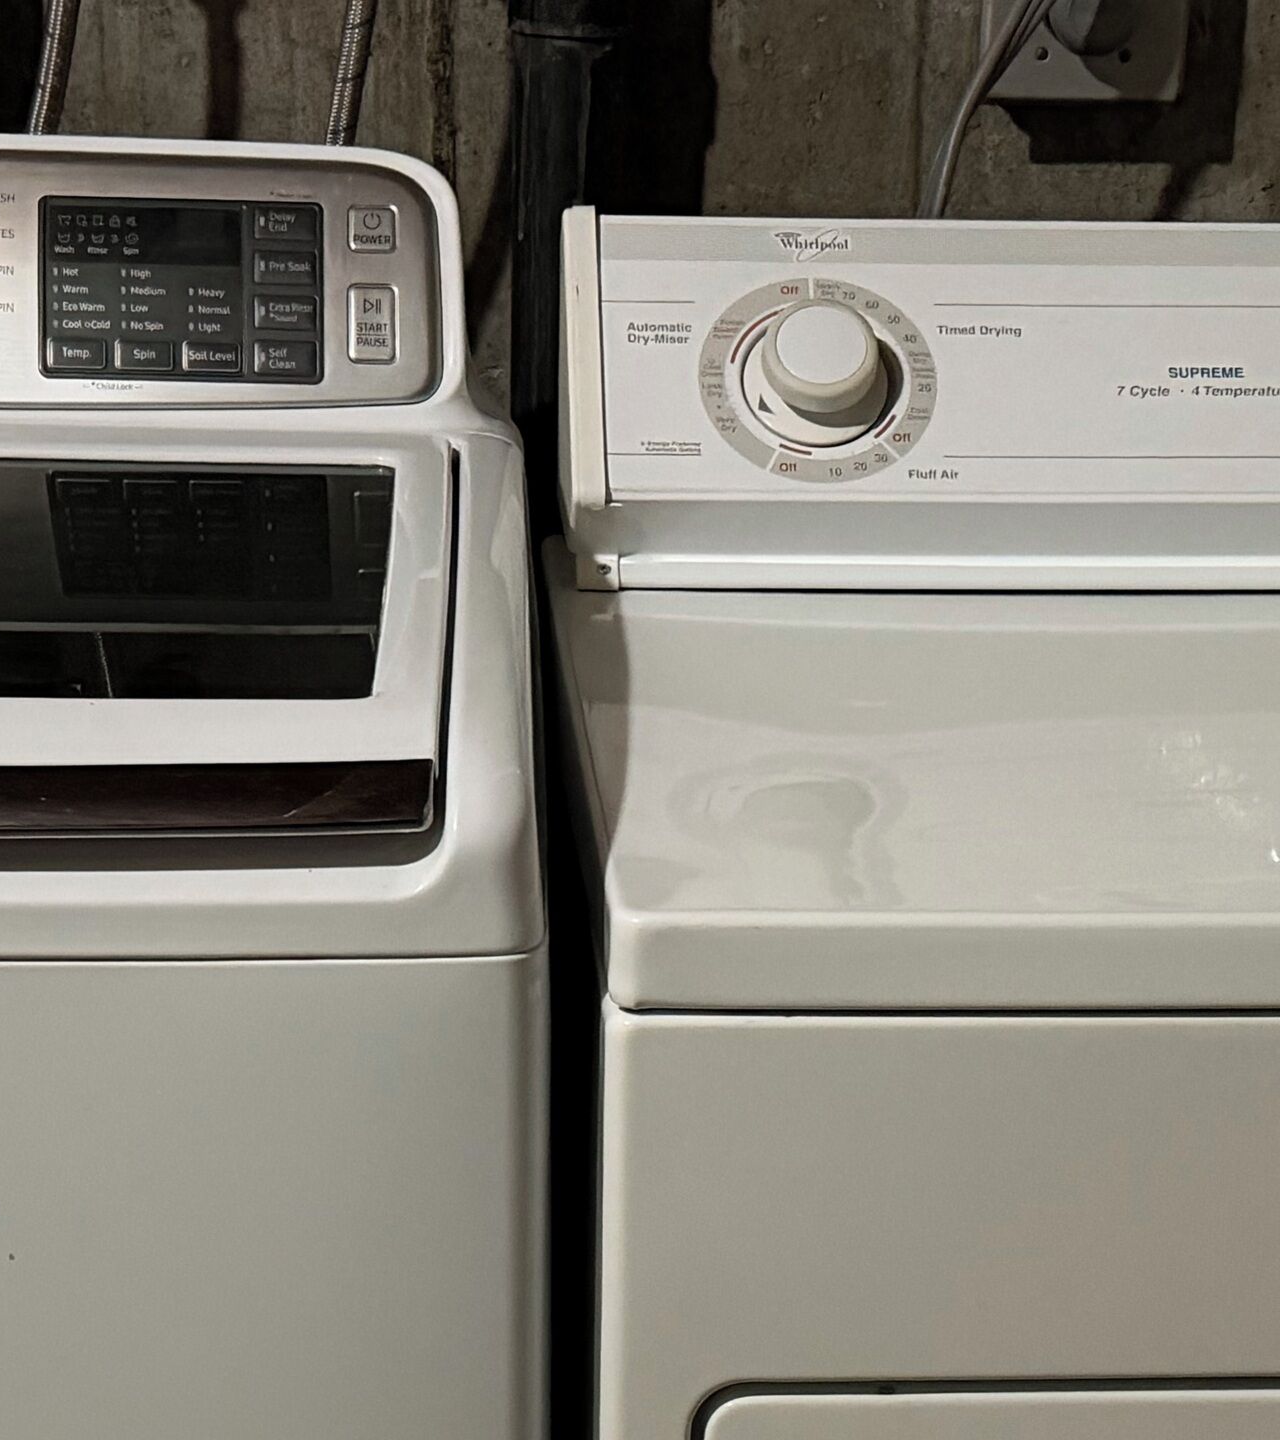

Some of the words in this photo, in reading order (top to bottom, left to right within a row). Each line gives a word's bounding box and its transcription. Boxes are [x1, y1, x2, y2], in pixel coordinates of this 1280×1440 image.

[353, 234, 391, 245] POWER
[774, 231, 849, 252] Whirlpool
[62, 268, 79, 276] Hot
[269, 262, 286, 271] Pre
[287, 262, 311, 272] Soak
[130, 269, 151, 279] High
[62, 285, 89, 294] Warm
[130, 287, 166, 296] Medium
[198, 288, 225, 299] Heavy
[780, 285, 799, 295] Off
[842, 291, 856, 300] 70
[62, 302, 78, 311] Eco
[79, 303, 106, 312] Warm
[130, 304, 148, 312] Low
[198, 305, 231, 315] Normal
[887, 315, 900, 324] 50
[130, 321, 144, 330] No
[145, 322, 164, 332] Spin
[198, 322, 221, 333] Light
[356, 322, 388, 333] START
[627, 321, 692, 334] Automatic
[936, 325, 976, 337] Timed
[979, 325, 1022, 339] Drying
[356, 336, 389, 347] PAUSE
[627, 333, 690, 346] Dry-Miser
[133, 349, 156, 361] Spin
[189, 350, 208, 361] Soil
[209, 351, 236, 362] Level
[268, 346, 287, 358] Self
[269, 359, 296, 369] Clean
[1168, 366, 1245, 379] SUPREME
[1117, 385, 1126, 397] 7
[1129, 385, 1170, 399] Cycle
[1191, 385, 1201, 397] 4
[893, 432, 911, 442] Off
[874, 453, 888, 463] 30
[779, 462, 797, 472] Off
[853, 462, 867, 471] 20
[828, 467, 842, 477] 10
[908, 468, 937, 480] Fluff
[940, 469, 959, 480] Air
